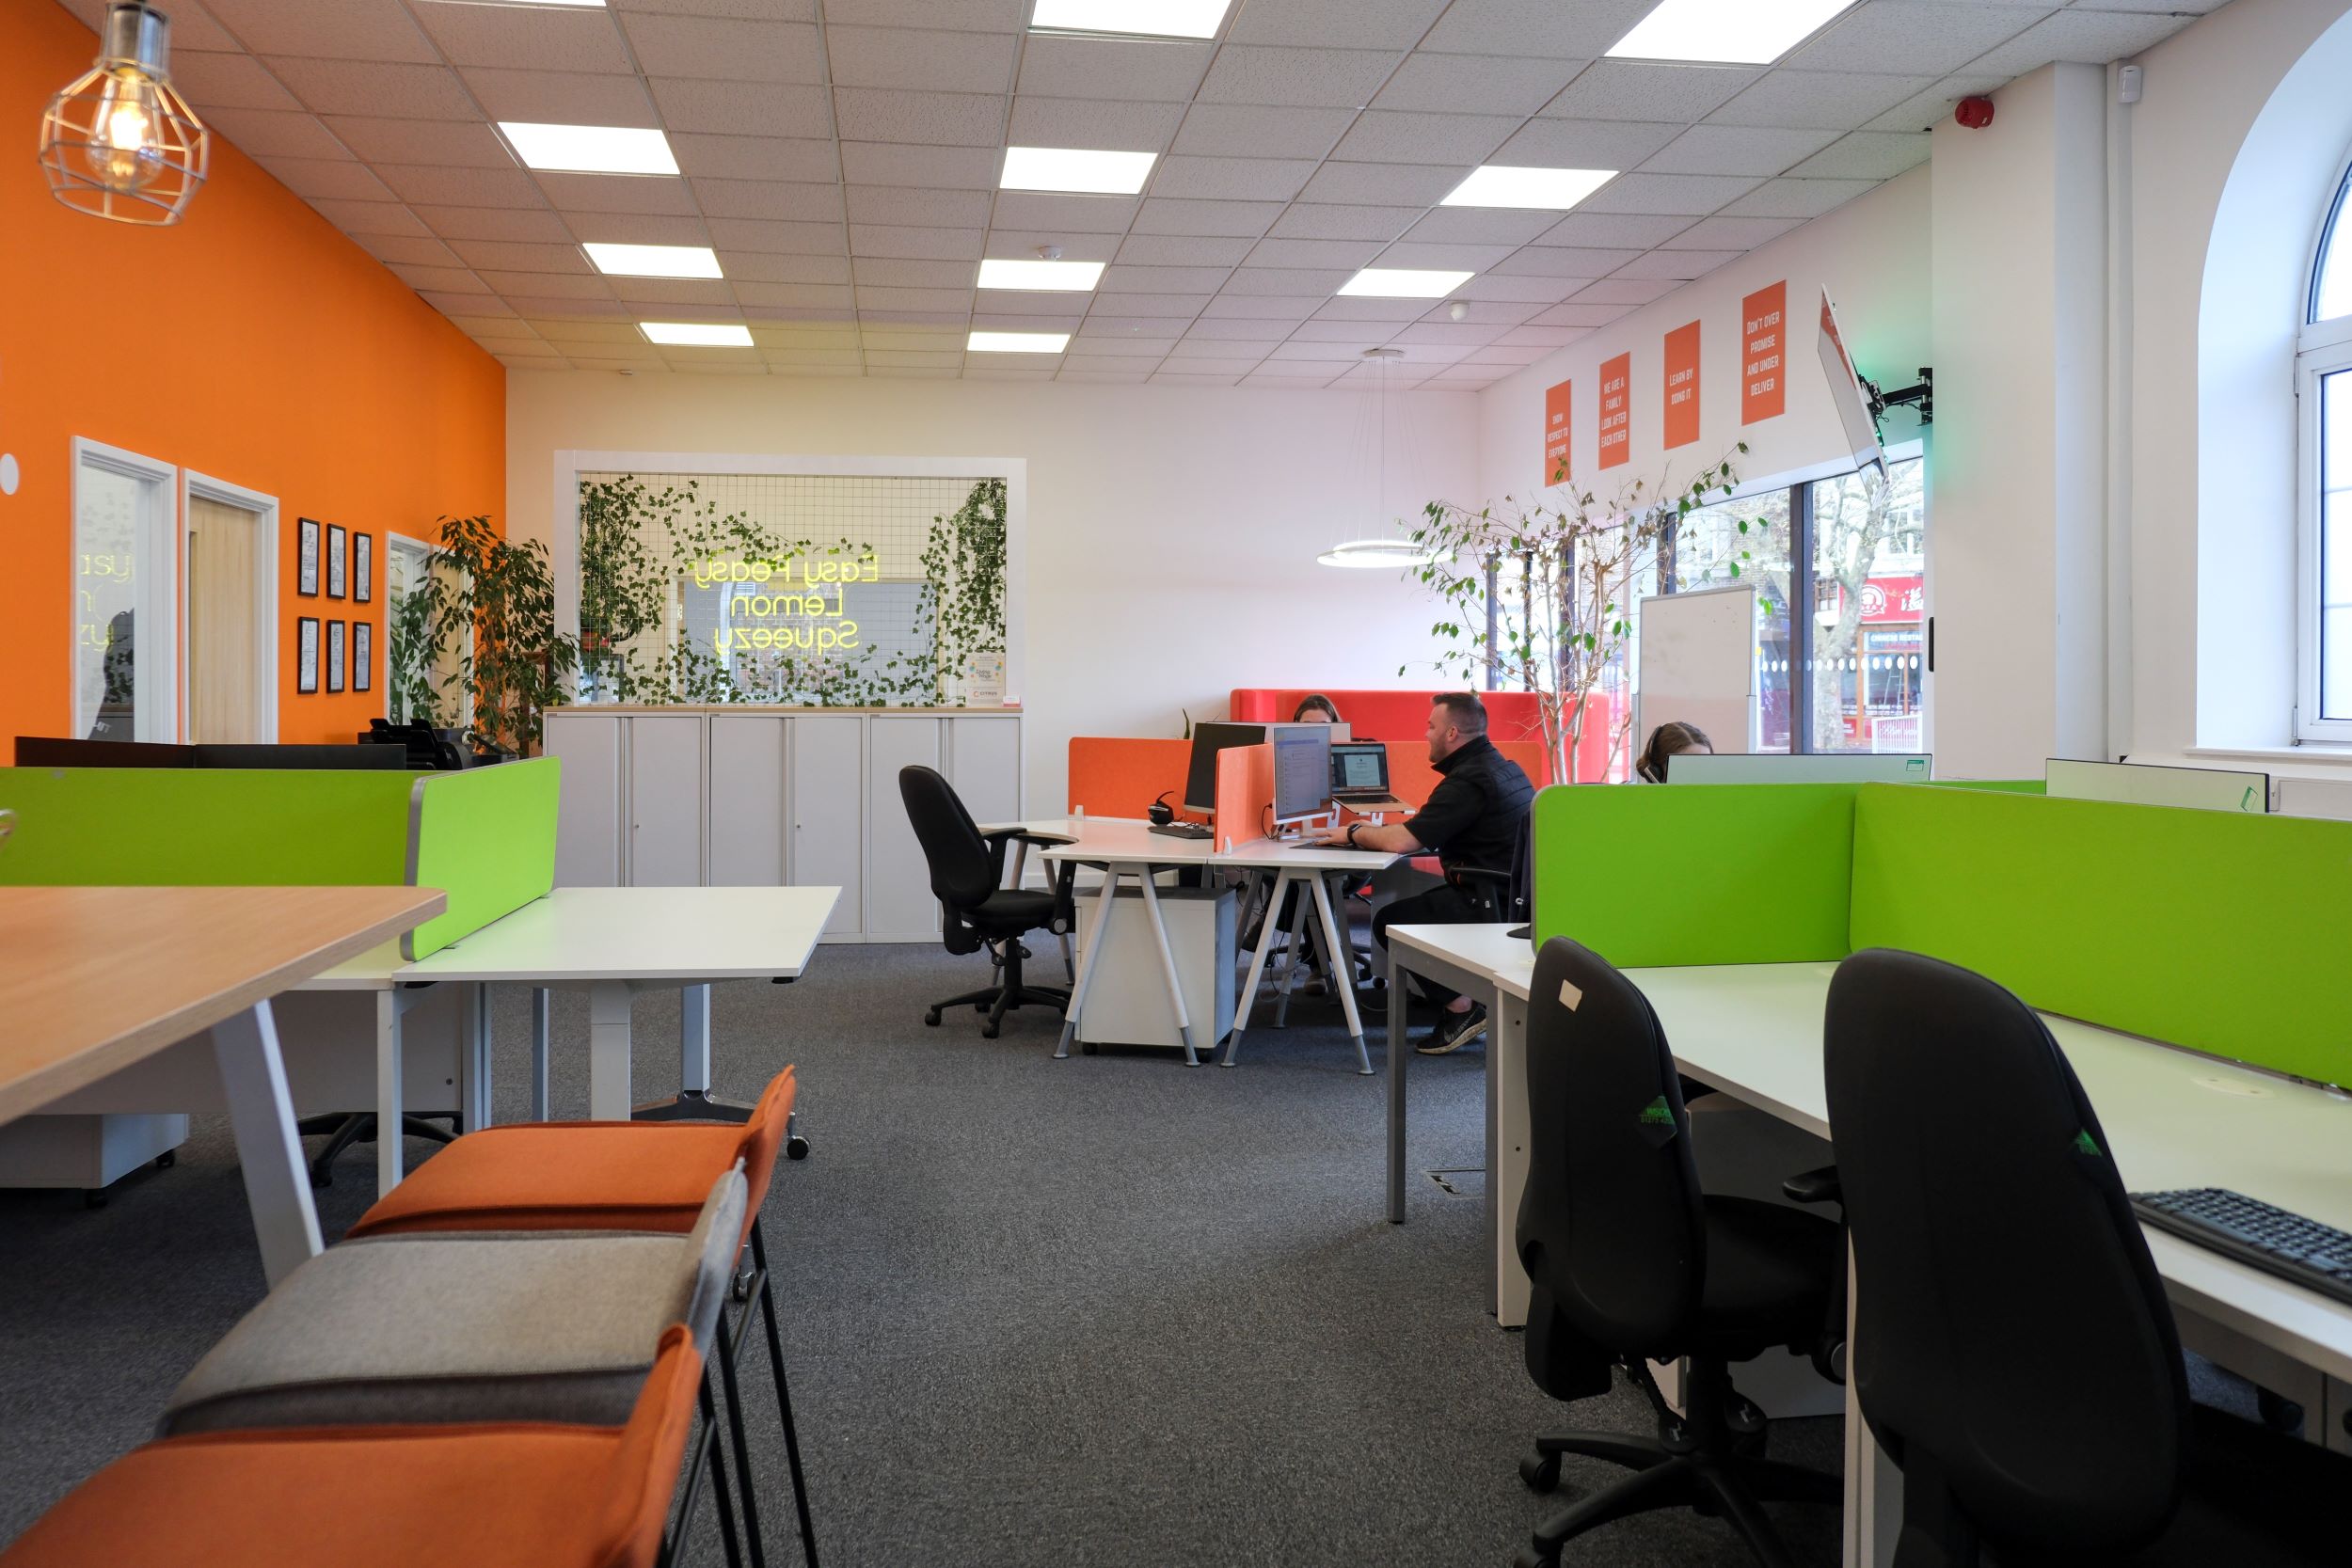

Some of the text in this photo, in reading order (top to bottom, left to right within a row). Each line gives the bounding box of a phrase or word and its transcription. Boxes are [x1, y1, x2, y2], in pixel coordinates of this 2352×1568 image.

[1747, 311, 1780, 335] DON'T OVER
[1751, 334, 1776, 355] PROMISE
[1747, 355, 1779, 377] AND UNDER
[1604, 382, 1611, 395] WE
[1611, 377, 1620, 392] ARE
[1670, 368, 1693, 387] LEARN BY
[1751, 378, 1774, 396] DELIVER
[1605, 394, 1621, 411] FAMILY
[1671, 388, 1692, 405] DOING IT
[1601, 411, 1627, 431] LOOK AFTER
[1601, 429, 1627, 449] EACH OTHER
